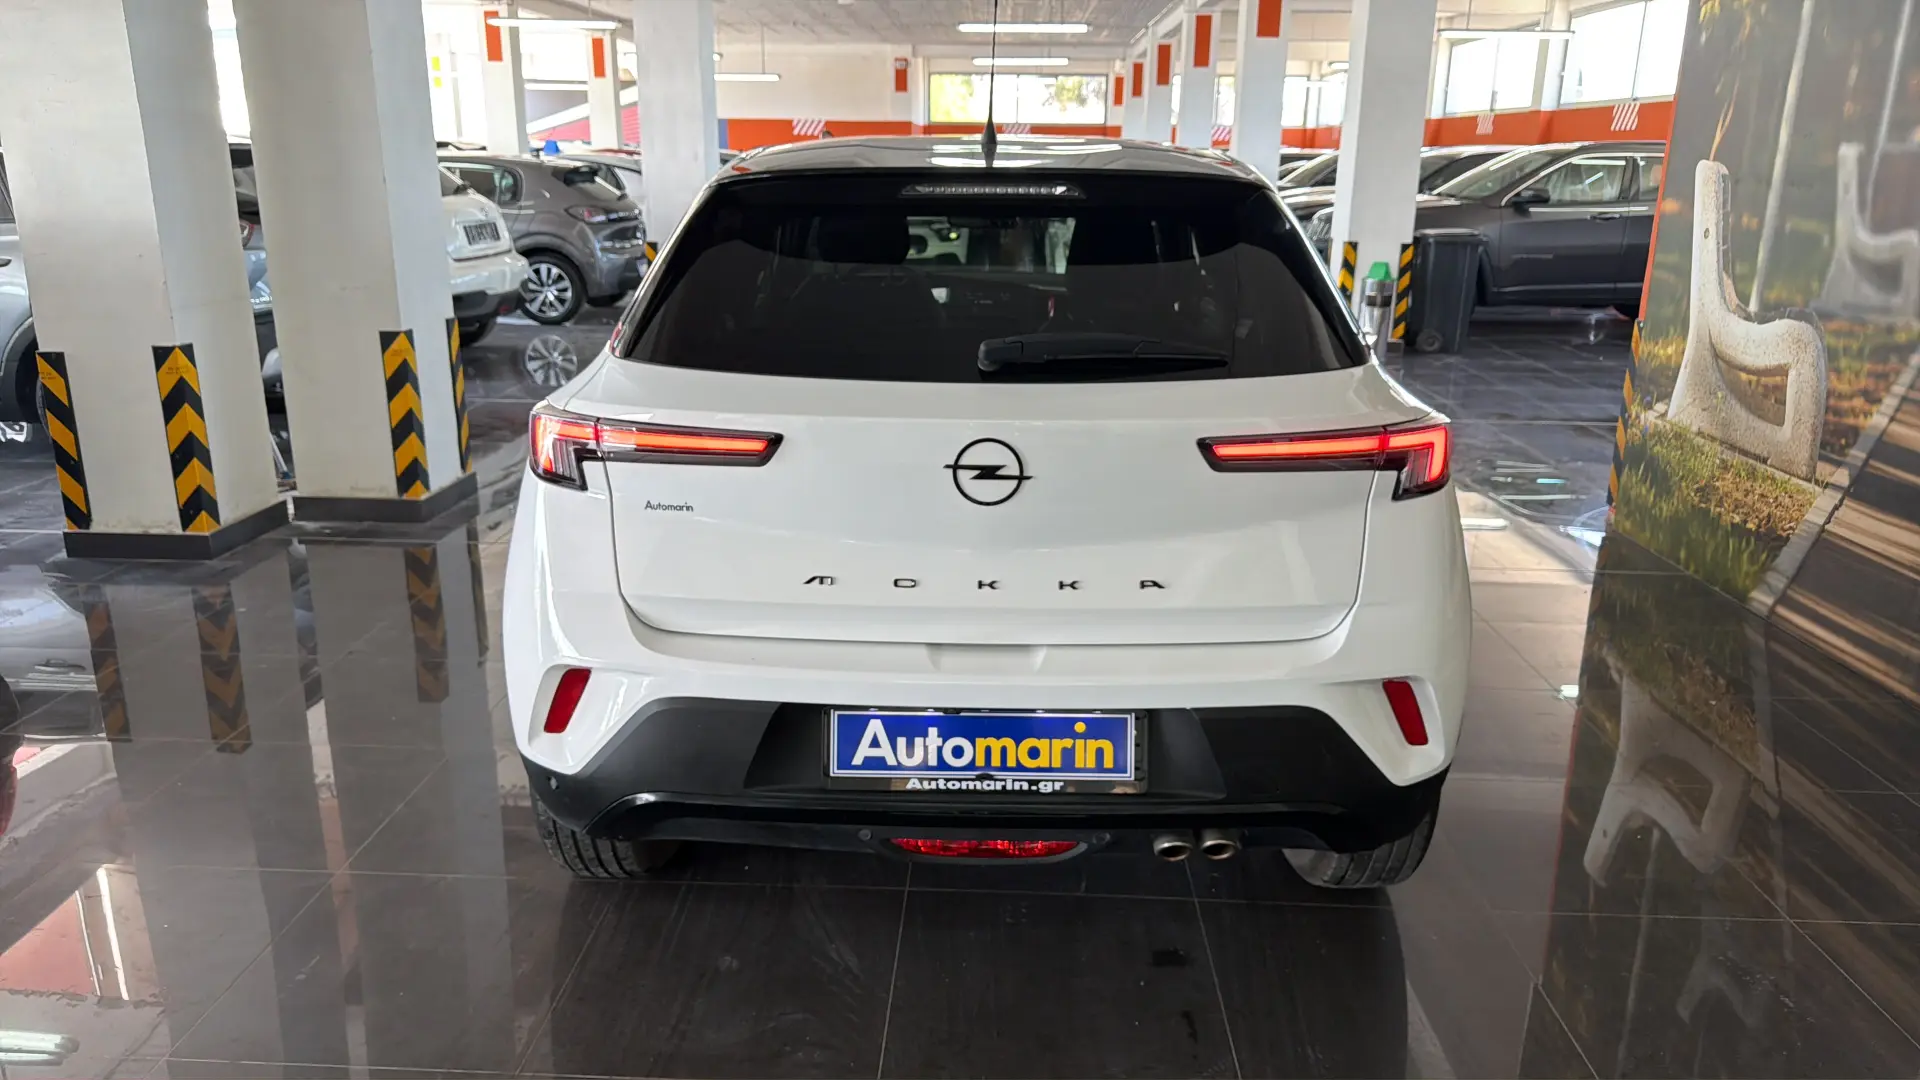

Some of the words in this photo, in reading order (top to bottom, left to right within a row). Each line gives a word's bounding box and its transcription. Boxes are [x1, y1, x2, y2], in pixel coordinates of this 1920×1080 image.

[644, 500, 694, 512] Automarin
[851, 718, 1114, 769] Automarin
[905, 777, 1064, 793] Automarin.gr
